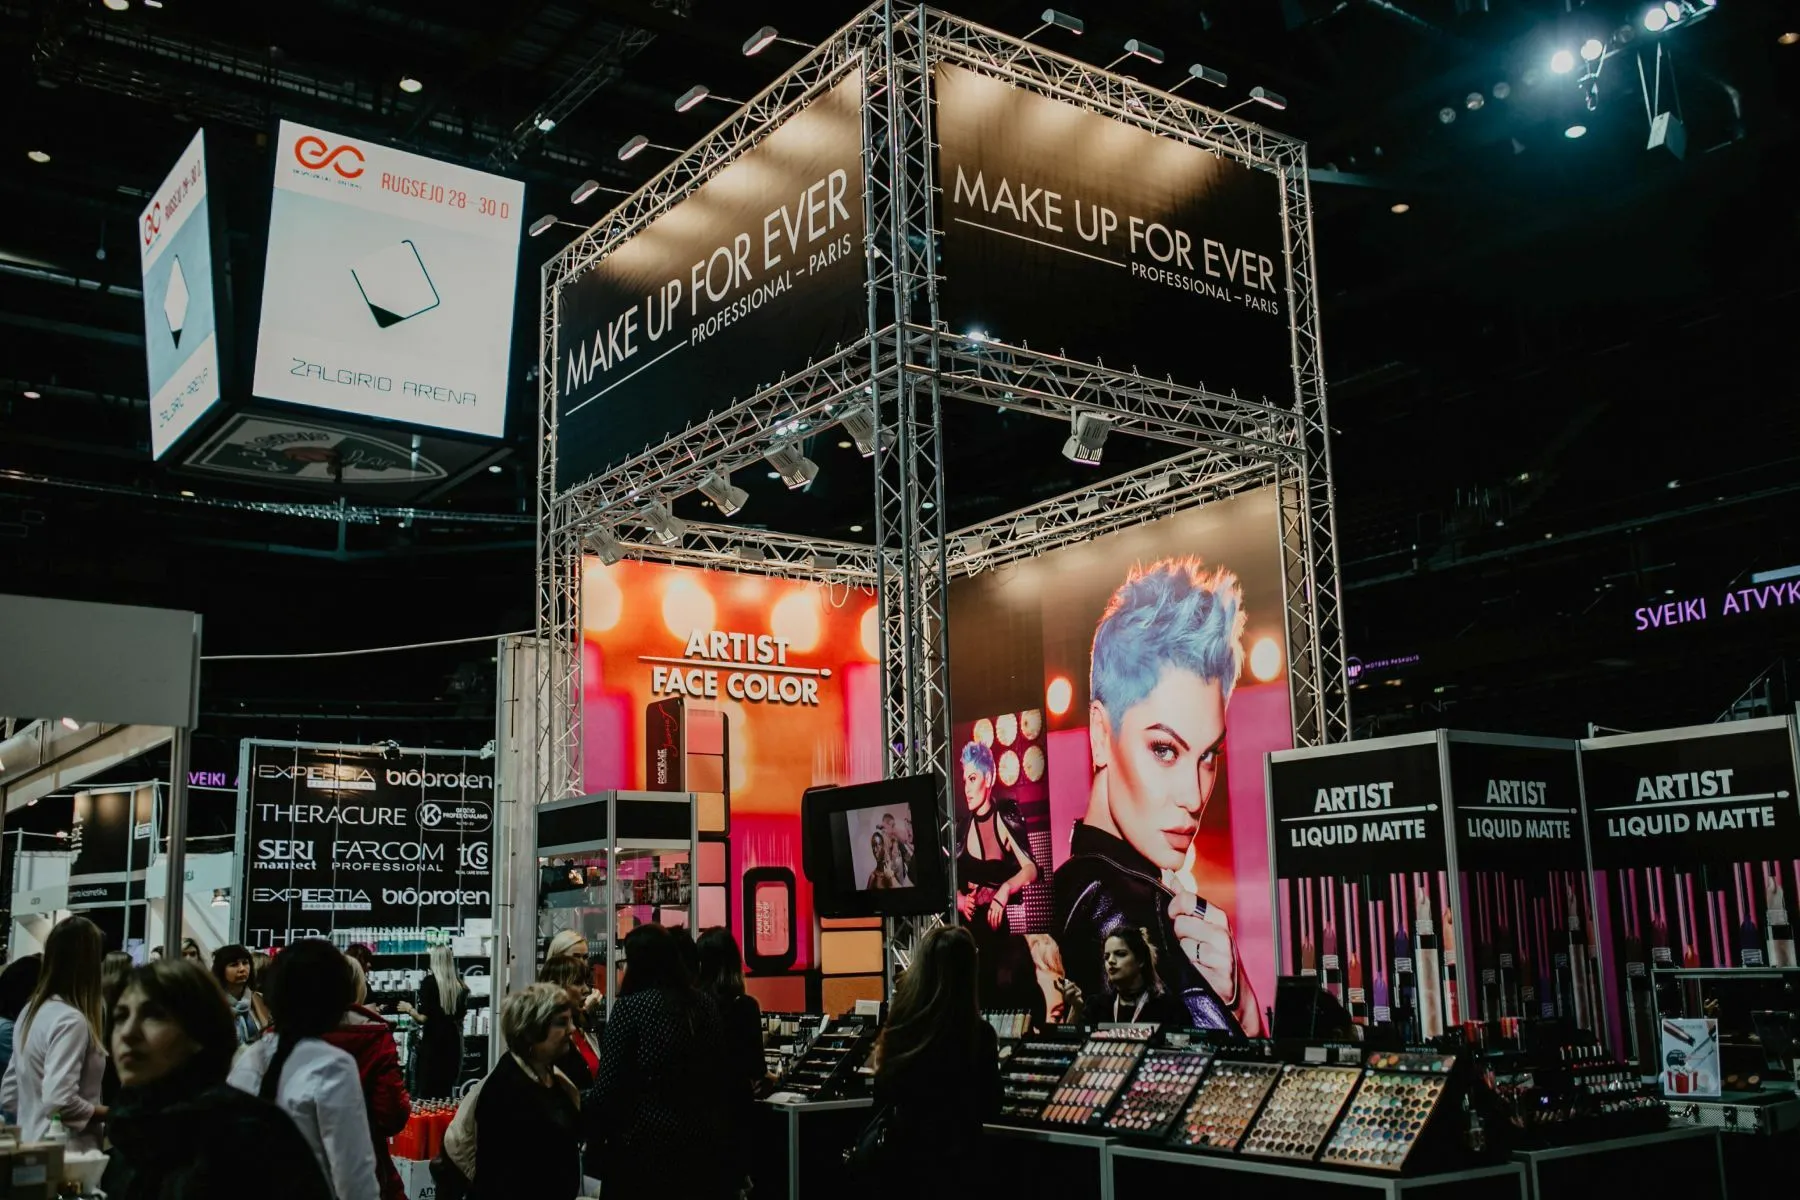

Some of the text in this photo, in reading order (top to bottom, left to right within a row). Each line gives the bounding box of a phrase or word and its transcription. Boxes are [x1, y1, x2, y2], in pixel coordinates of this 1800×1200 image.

[381, 172, 444, 203] RUGSEJO
[954, 164, 1277, 294] MAKE UP FOR EVER
[565, 168, 850, 397] MAKE UP FOR EVER
[691, 270, 793, 347] PROFESSIONAL
[809, 233, 851, 276] PARIS
[1131, 261, 1231, 302] PROFESSIONAL
[1245, 294, 1279, 315] PARIS
[290, 357, 477, 406] ZALGIRIO ARENA
[1635, 581, 1800, 631] SVEIKI ATVYK
[684, 628, 790, 665] ARTIST
[652, 666, 819, 704] FACE COLOR
[187, 771, 226, 786] VEIKI
[1485, 779, 1547, 806] ARTIST
[1635, 769, 1734, 802] ARTIST
[1314, 782, 1394, 813] ARTIST
[255, 803, 407, 826] THERACURE
[1468, 818, 1571, 840] LIQUID MATTE
[1608, 806, 1775, 838] LIQUID MATTE
[1291, 818, 1426, 847] LIQUID MATTE
[257, 839, 315, 860] SERI
[332, 840, 444, 860] FARCOM
[331, 861, 444, 872] PROFESSIONAL
[253, 888, 371, 902] EXPERTIA
